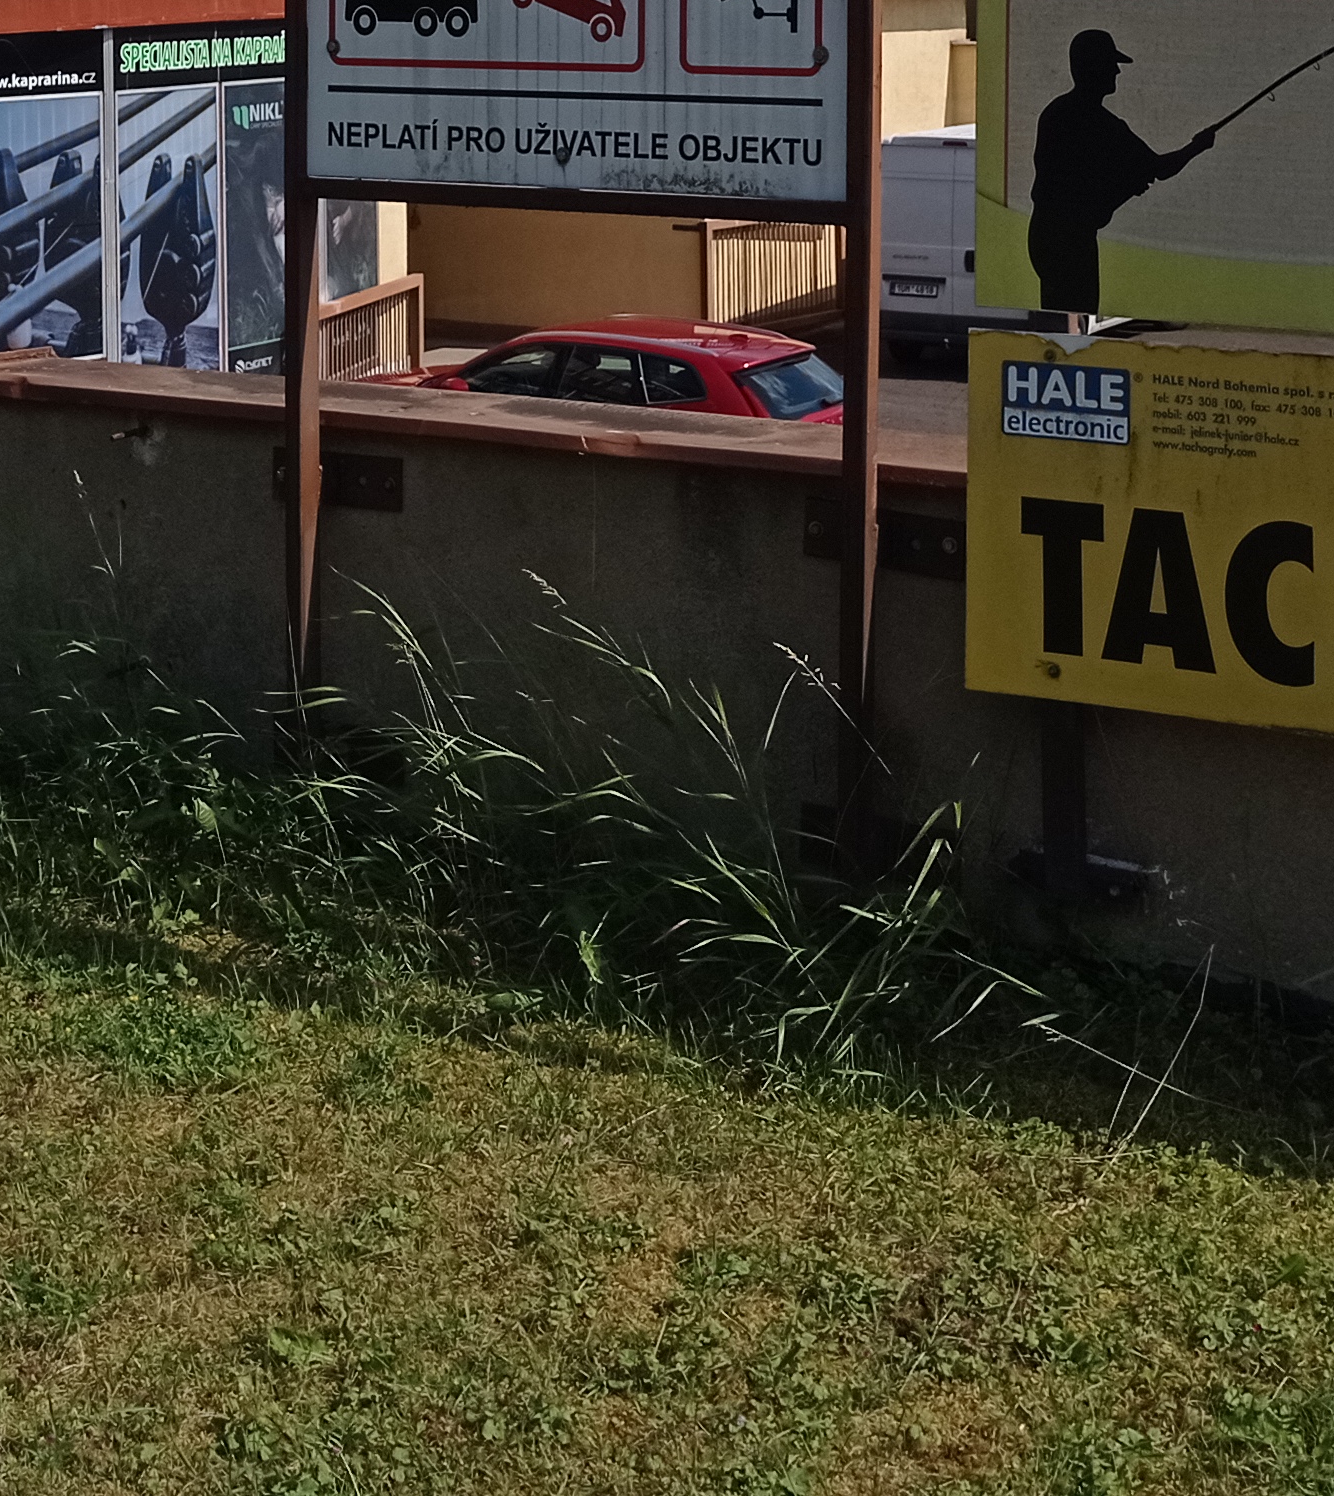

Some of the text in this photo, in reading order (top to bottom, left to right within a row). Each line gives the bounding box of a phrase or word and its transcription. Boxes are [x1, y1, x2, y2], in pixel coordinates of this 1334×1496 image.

[120, 39, 210, 73] SPECIALISTA
[211, 38, 233, 68] NA
[327, 119, 823, 167] NEPLATÍ PRO UŽIVATELE OBJEKTU
[1006, 365, 1126, 411] HALE
[1152, 374, 1184, 386] HALE
[1188, 377, 1220, 389] Nord
[1224, 380, 1280, 395] Bohemia
[1283, 386, 1314, 399] spol.
[1174, 394, 1193, 406] 475
[1198, 396, 1218, 408] 308
[1224, 398, 1246, 412] 100,
[1275, 404, 1296, 415] 475
[1301, 405, 1322, 417] 308
[1187, 410, 1207, 422] 603
[1212, 412, 1230, 424] 221
[1237, 415, 1257, 426] 999
[1007, 411, 1126, 442] electronic
